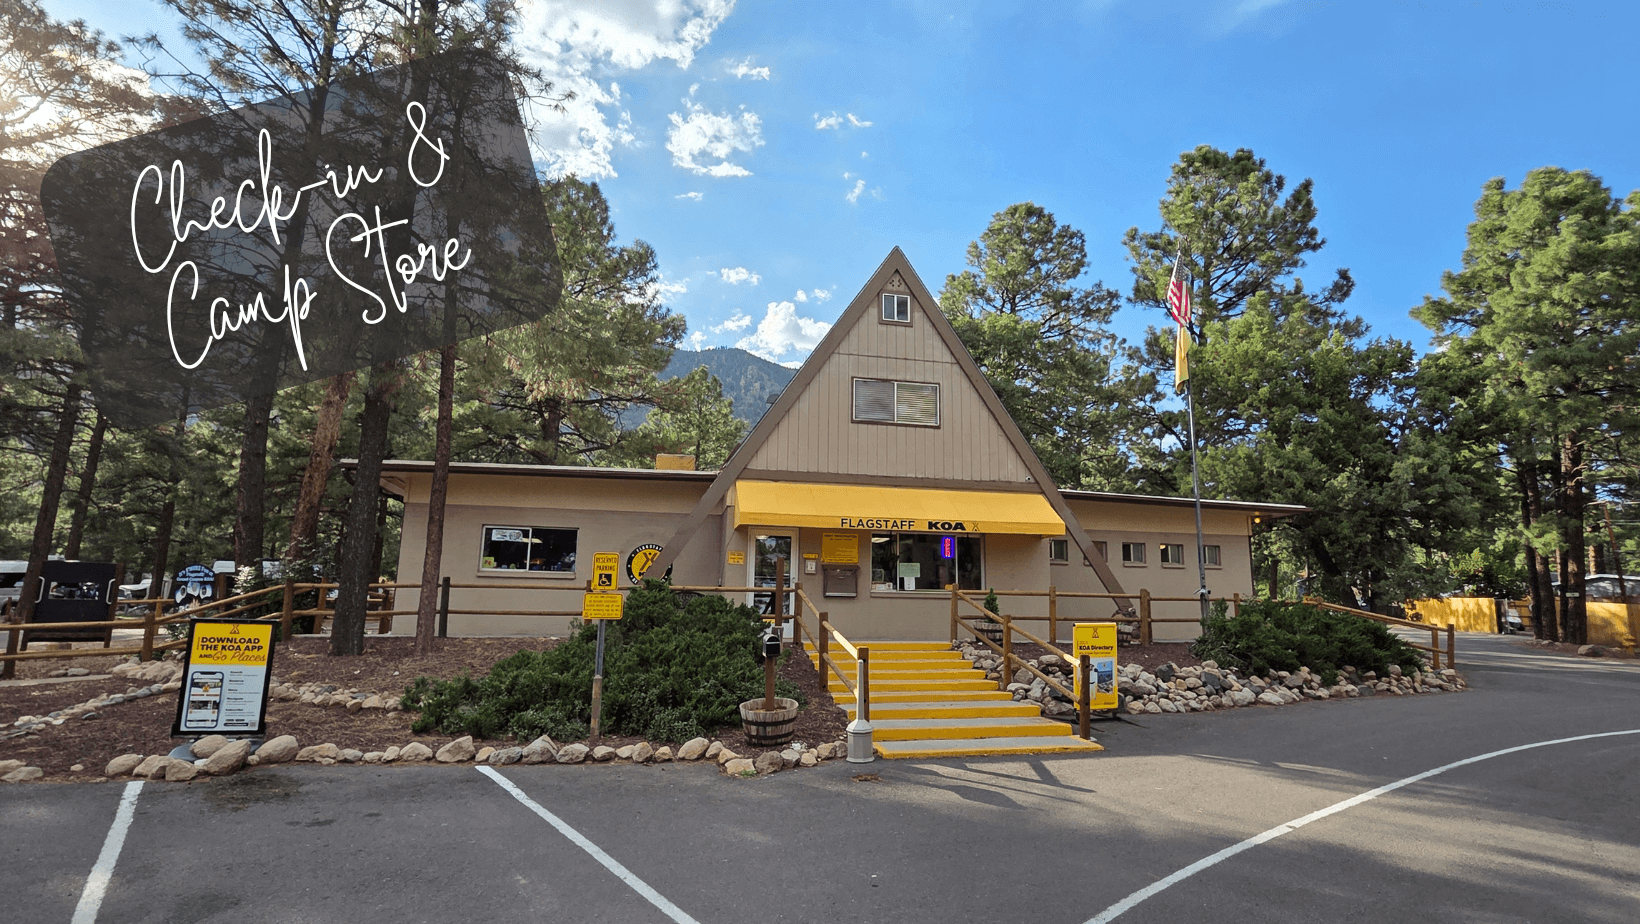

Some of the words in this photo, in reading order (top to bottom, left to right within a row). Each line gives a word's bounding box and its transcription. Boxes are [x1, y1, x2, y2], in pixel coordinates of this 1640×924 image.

[840, 518, 915, 529] FLAGSTAFF
[927, 520, 967, 531] KOA
[636, 544, 663, 553] FLAGSTAF
[201, 636, 260, 645] DOWNLOAD
[200, 643, 219, 651] THE
[221, 644, 242, 652] KOA
[212, 651, 227, 662] Go
[230, 651, 266, 662] Places
